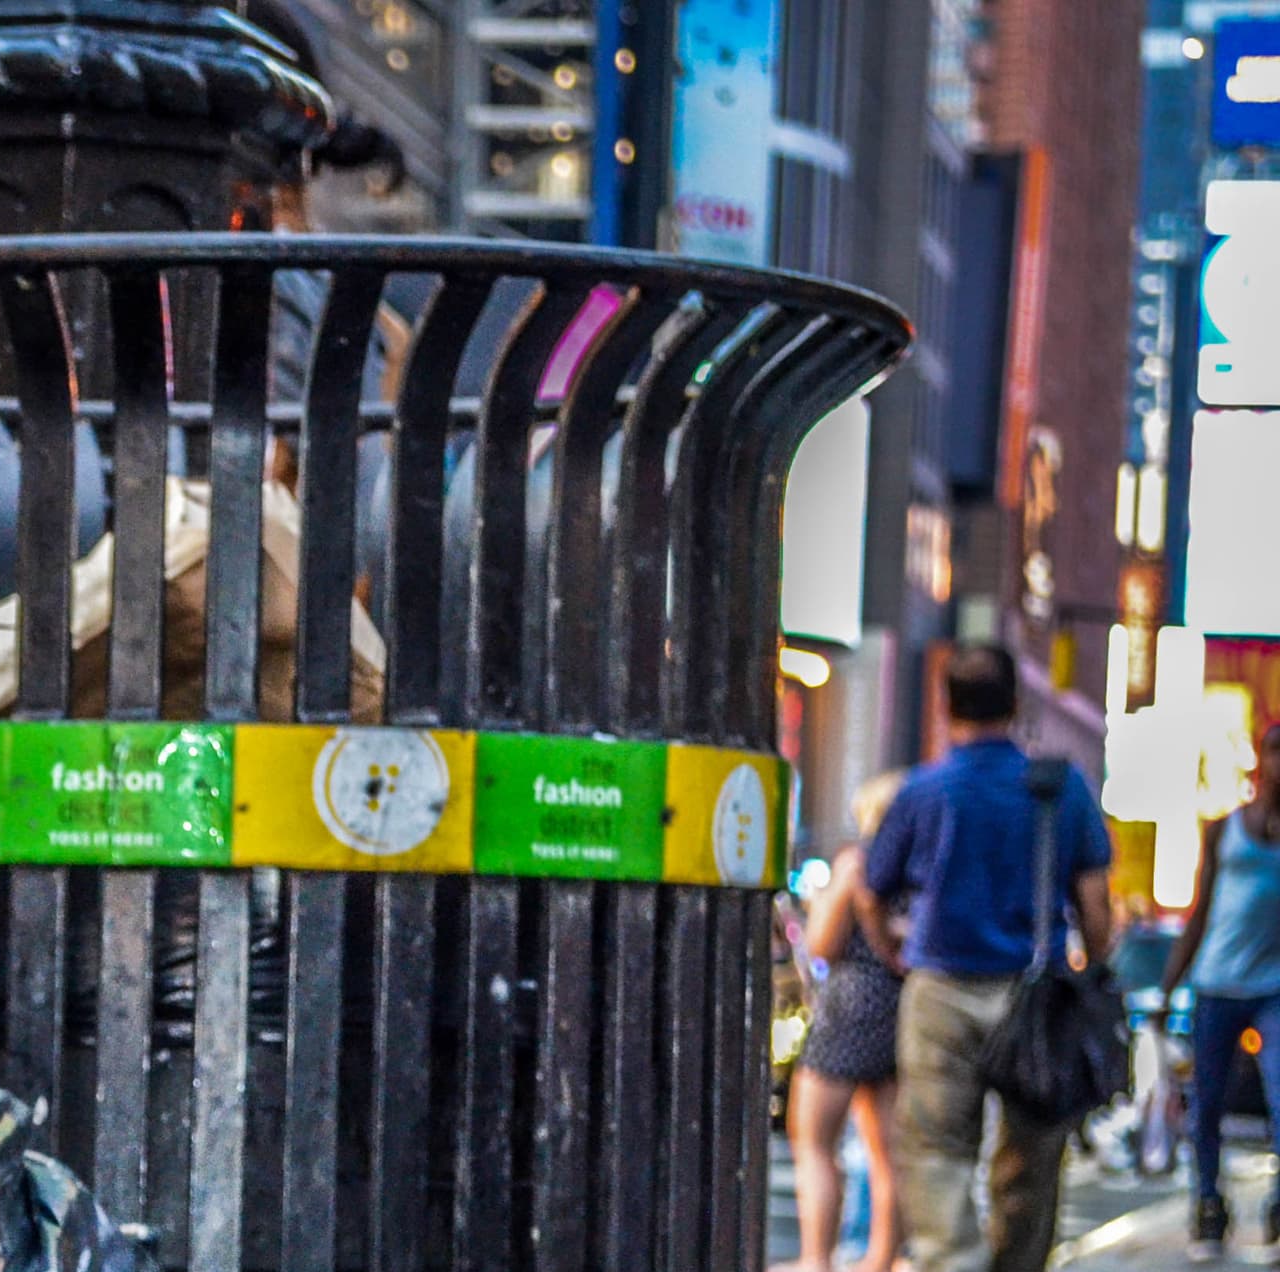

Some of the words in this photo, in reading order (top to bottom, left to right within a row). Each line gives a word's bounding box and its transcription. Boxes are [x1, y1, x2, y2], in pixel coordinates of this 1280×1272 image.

[51, 763, 164, 792] fashion
[582, 756, 615, 780] the
[533, 775, 622, 808] fashion
